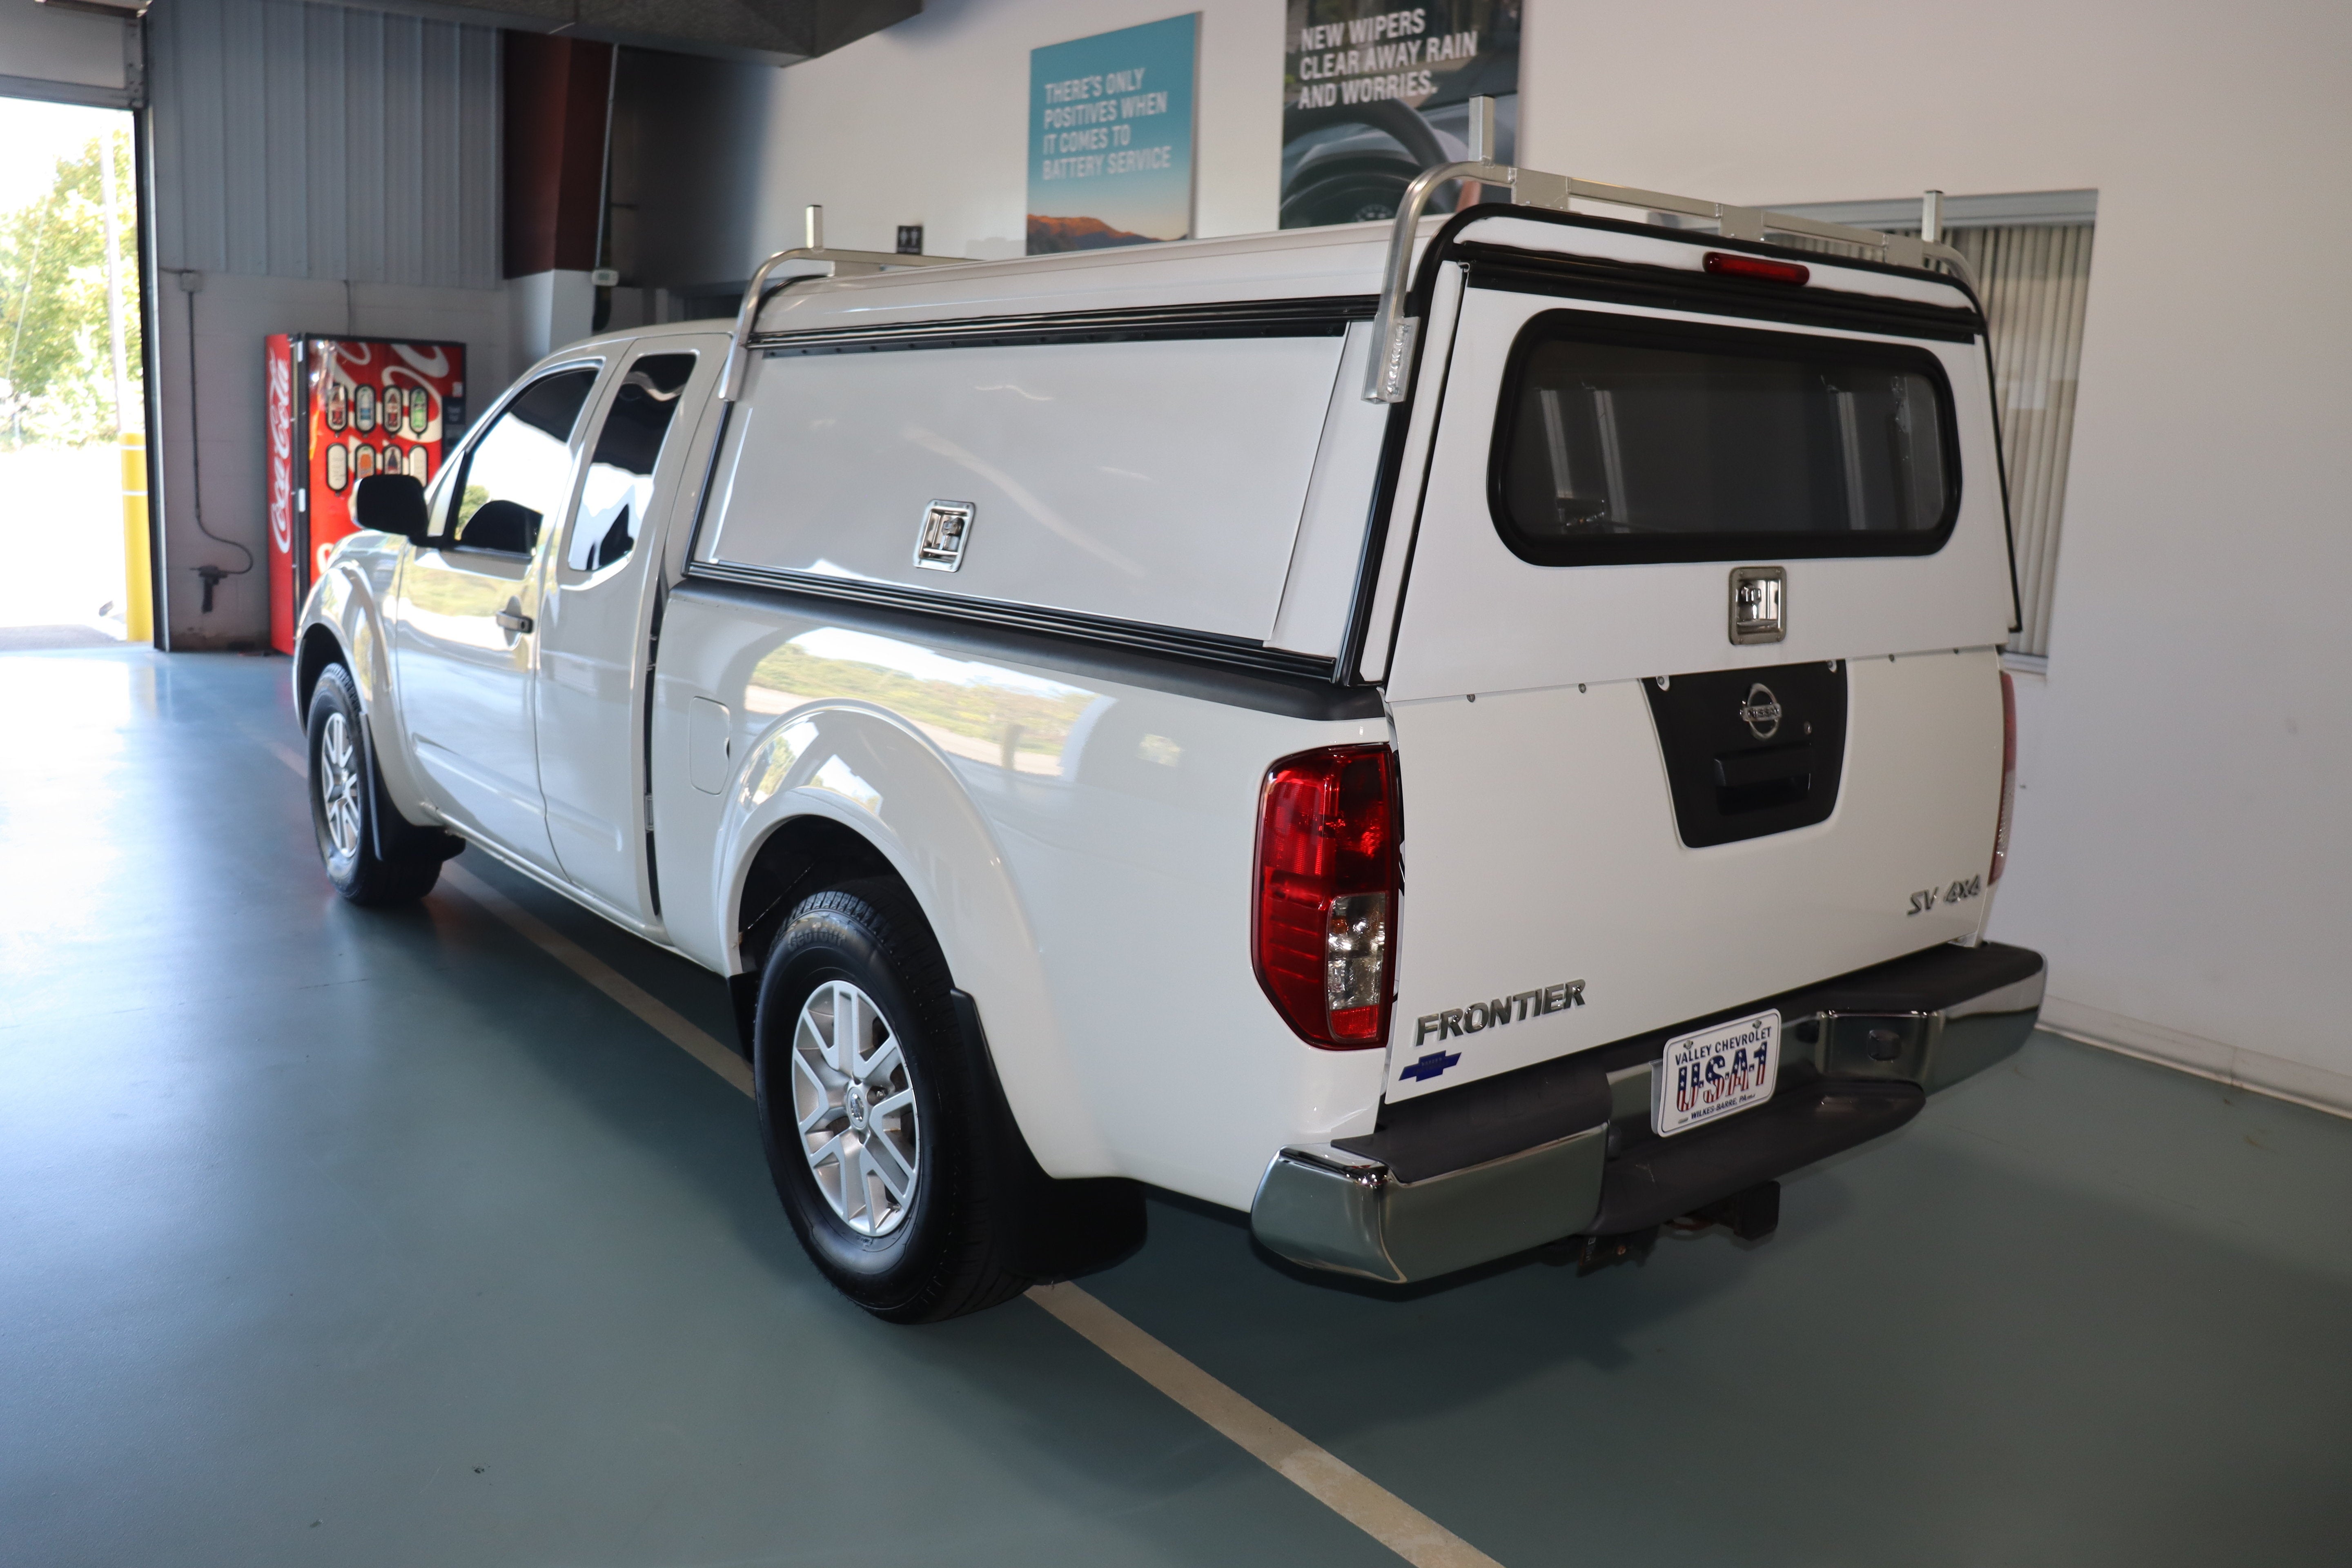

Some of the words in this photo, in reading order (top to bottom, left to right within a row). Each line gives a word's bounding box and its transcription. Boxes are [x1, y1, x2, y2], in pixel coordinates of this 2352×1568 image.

[1301, 22, 1345, 51] NEW
[1348, 8, 1426, 44] WIPERS
[1299, 50, 1359, 81] CLEAR
[1364, 40, 1423, 72] AWAY
[1426, 30, 1479, 62] RAIN
[1045, 75, 1103, 105] THERE'S
[1106, 67, 1146, 95] ONLY
[1297, 83, 1337, 110] AND
[1341, 69, 1439, 105] WORRIES.
[1044, 99, 1118, 130] POSITIVES
[1120, 90, 1168, 119] WHEN
[1042, 133, 1057, 156] IT
[1059, 127, 1109, 154] COMES
[1112, 123, 1131, 147] TO
[1042, 154, 1106, 180] BATTERY
[1107, 145, 1172, 174] SERVICE
[1907, 886, 1939, 915] SV
[1414, 978, 1586, 1047] FRONTIER
[1675, 1044, 1712, 1066] VALLEY
[1715, 1026, 1772, 1054] CHEVROLET
[1739, 1095, 1747, 1103] PA
